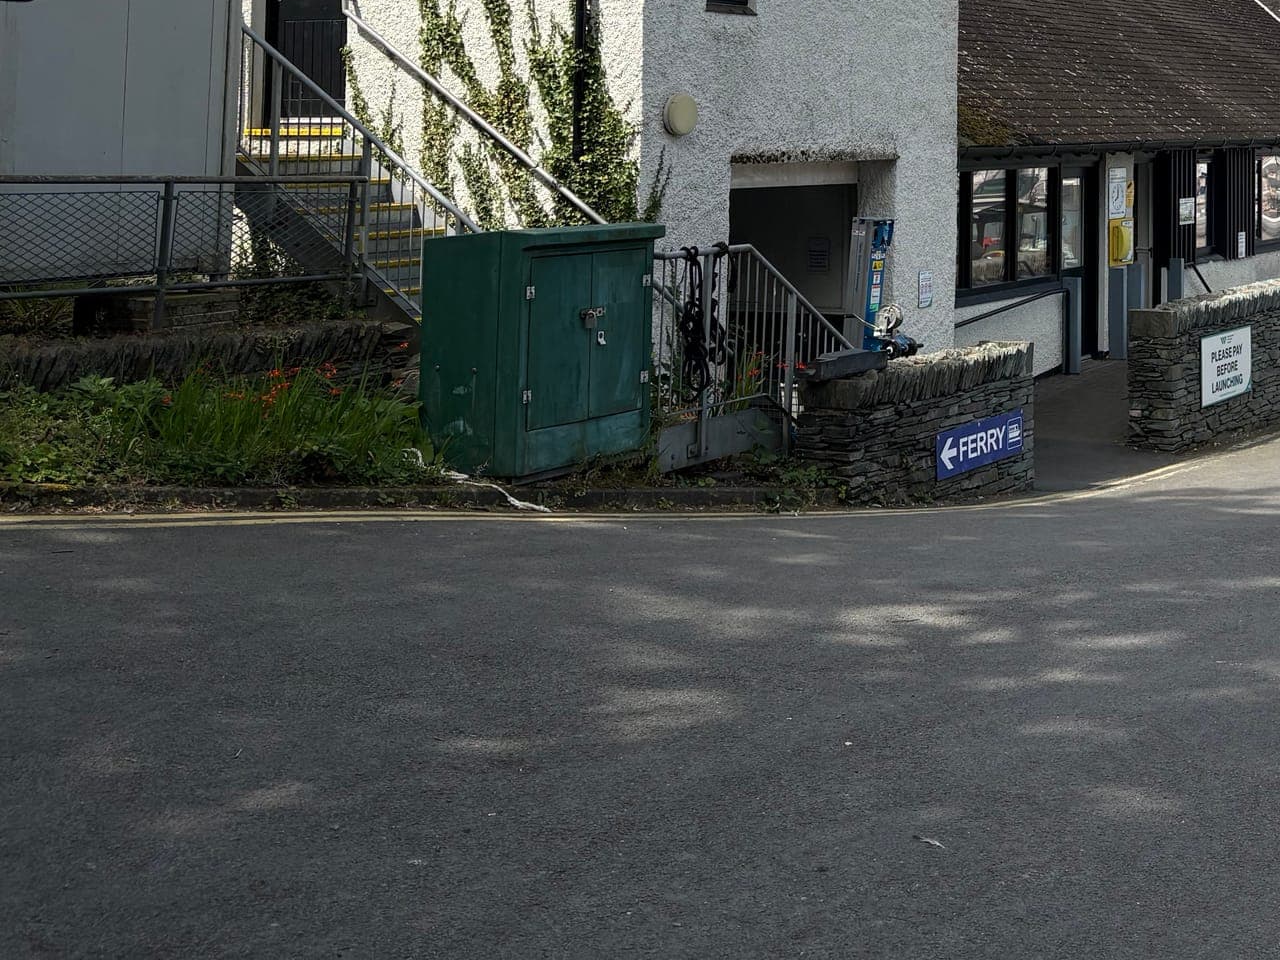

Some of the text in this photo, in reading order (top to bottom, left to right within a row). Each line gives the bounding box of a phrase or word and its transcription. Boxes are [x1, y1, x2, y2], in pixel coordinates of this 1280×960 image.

[1211, 343, 1243, 363] PLEASE PAY
[1216, 359, 1239, 377] BEFORE
[1211, 373, 1244, 394] LAUNCHING
[959, 424, 1006, 462] FERRY
